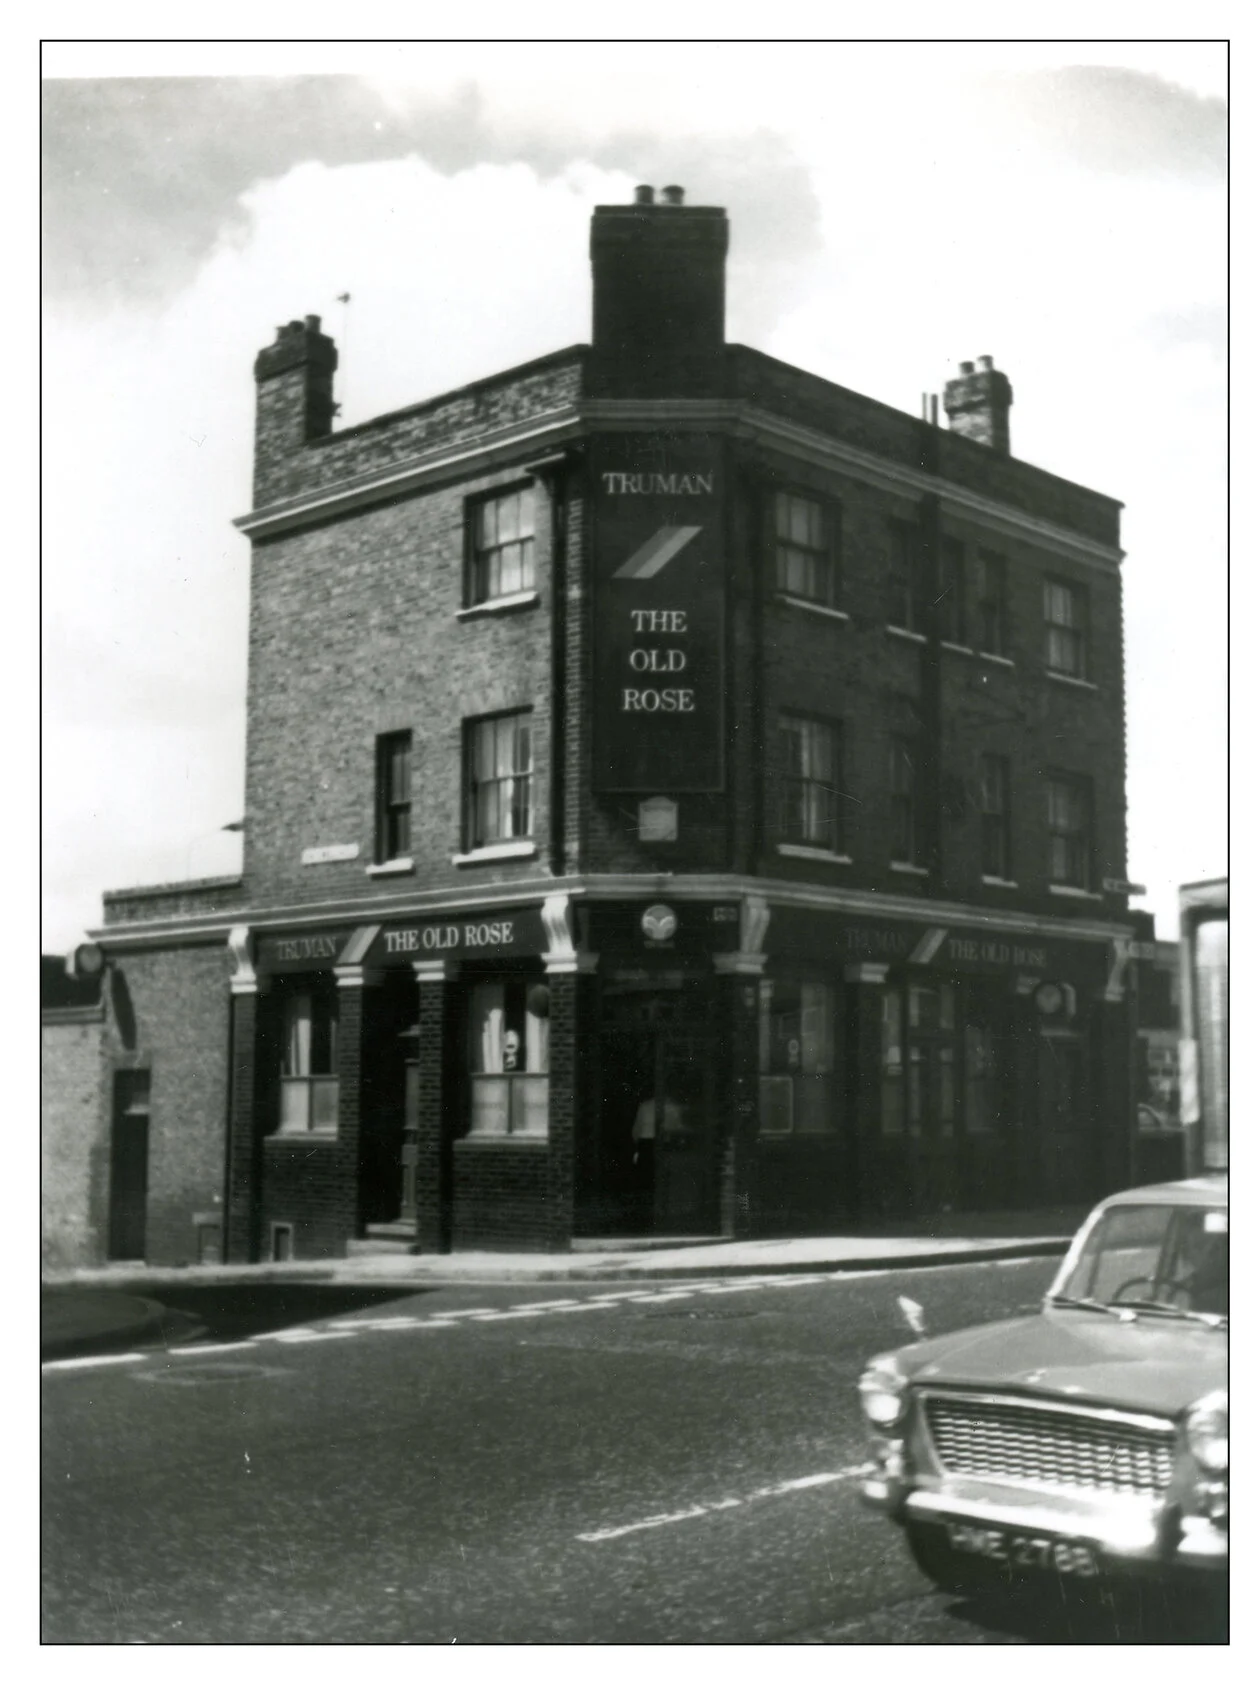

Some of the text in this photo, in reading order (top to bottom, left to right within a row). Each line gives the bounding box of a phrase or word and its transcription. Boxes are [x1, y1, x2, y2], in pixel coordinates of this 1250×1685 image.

[602, 472, 713, 494] TRUMAN
[630, 610, 688, 633] THE
[629, 649, 686, 672] OLD
[622, 689, 696, 712] ROSE
[384, 922, 514, 952] THE OLD ROSE
[948, 939, 979, 961] THE
[981, 942, 1010, 963] OLD
